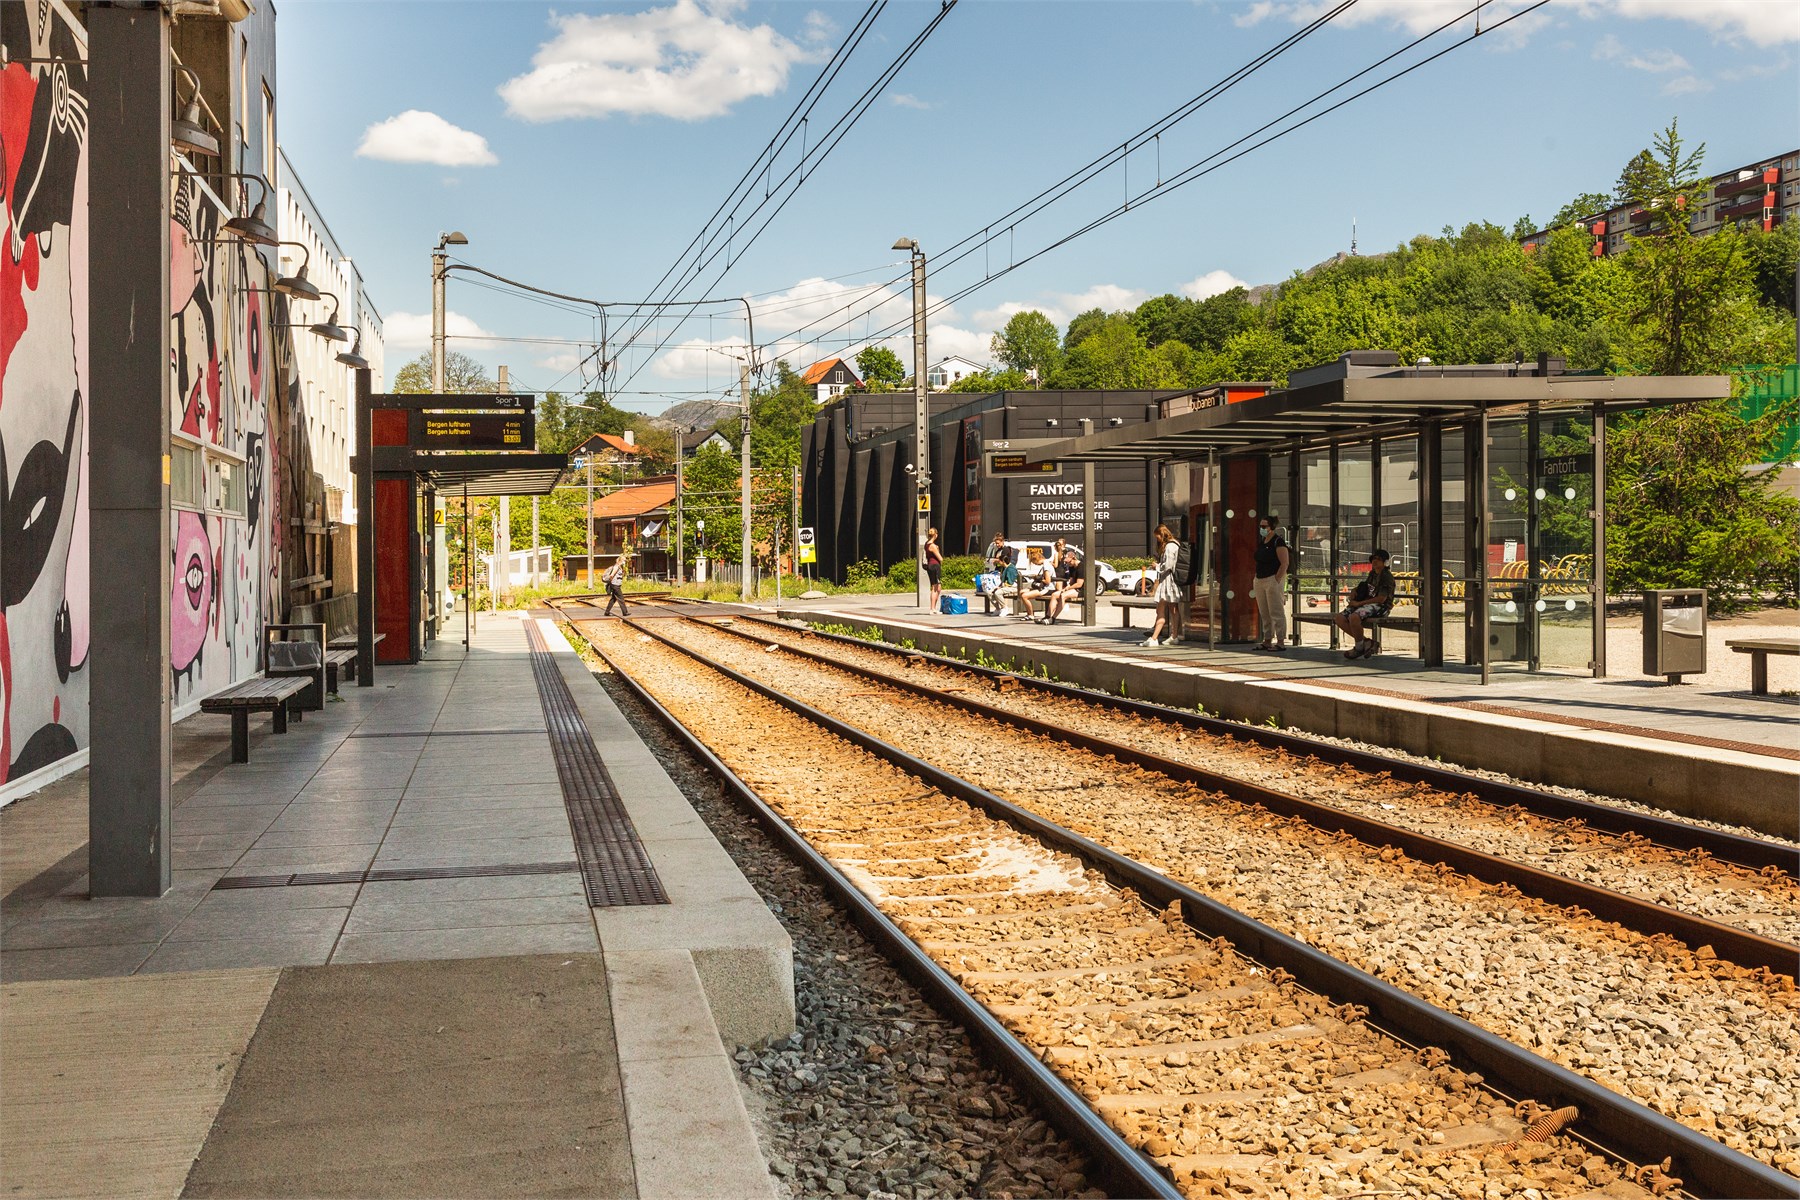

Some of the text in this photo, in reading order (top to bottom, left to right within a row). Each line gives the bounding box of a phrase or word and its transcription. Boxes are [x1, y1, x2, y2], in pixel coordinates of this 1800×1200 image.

[495, 396, 521, 406] Spor 1
[427, 428, 448, 436] Bergen
[1543, 457, 1577, 475] Fantoft
[1030, 484, 1084, 496] FANTOF
[920, 496, 928, 510] 2
[435, 509, 442, 524] 2
[1031, 511, 1110, 521] TRENINGSSTER
